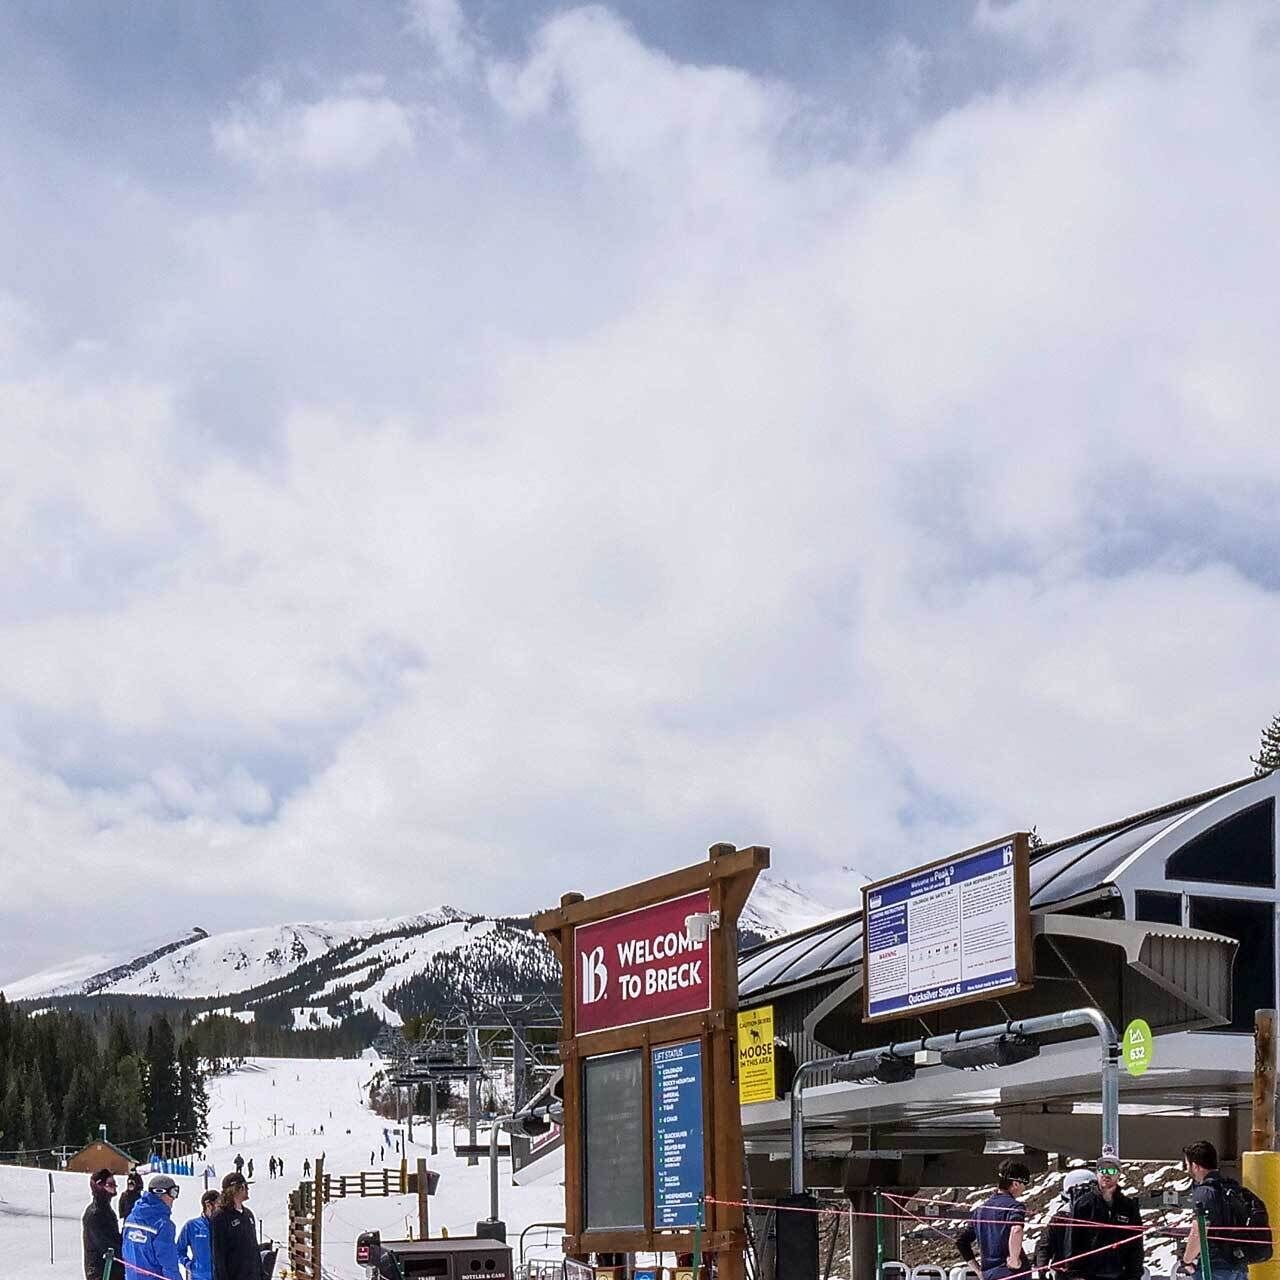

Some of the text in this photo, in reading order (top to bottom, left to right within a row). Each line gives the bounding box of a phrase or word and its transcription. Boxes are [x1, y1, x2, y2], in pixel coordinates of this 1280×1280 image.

[934, 868, 949, 881] Peak
[949, 866, 954, 876] 9
[619, 960, 702, 1000] TO BRECK
[908, 990, 939, 1005] Quicksilver
[939, 986, 956, 998] Super
[956, 983, 961, 993] 6
[654, 1048, 683, 1061] LIFT STATUS
[739, 1043, 772, 1060] MOOSE
[746, 1059, 758, 1067] THIS
[758, 1057, 772, 1065] AREA
